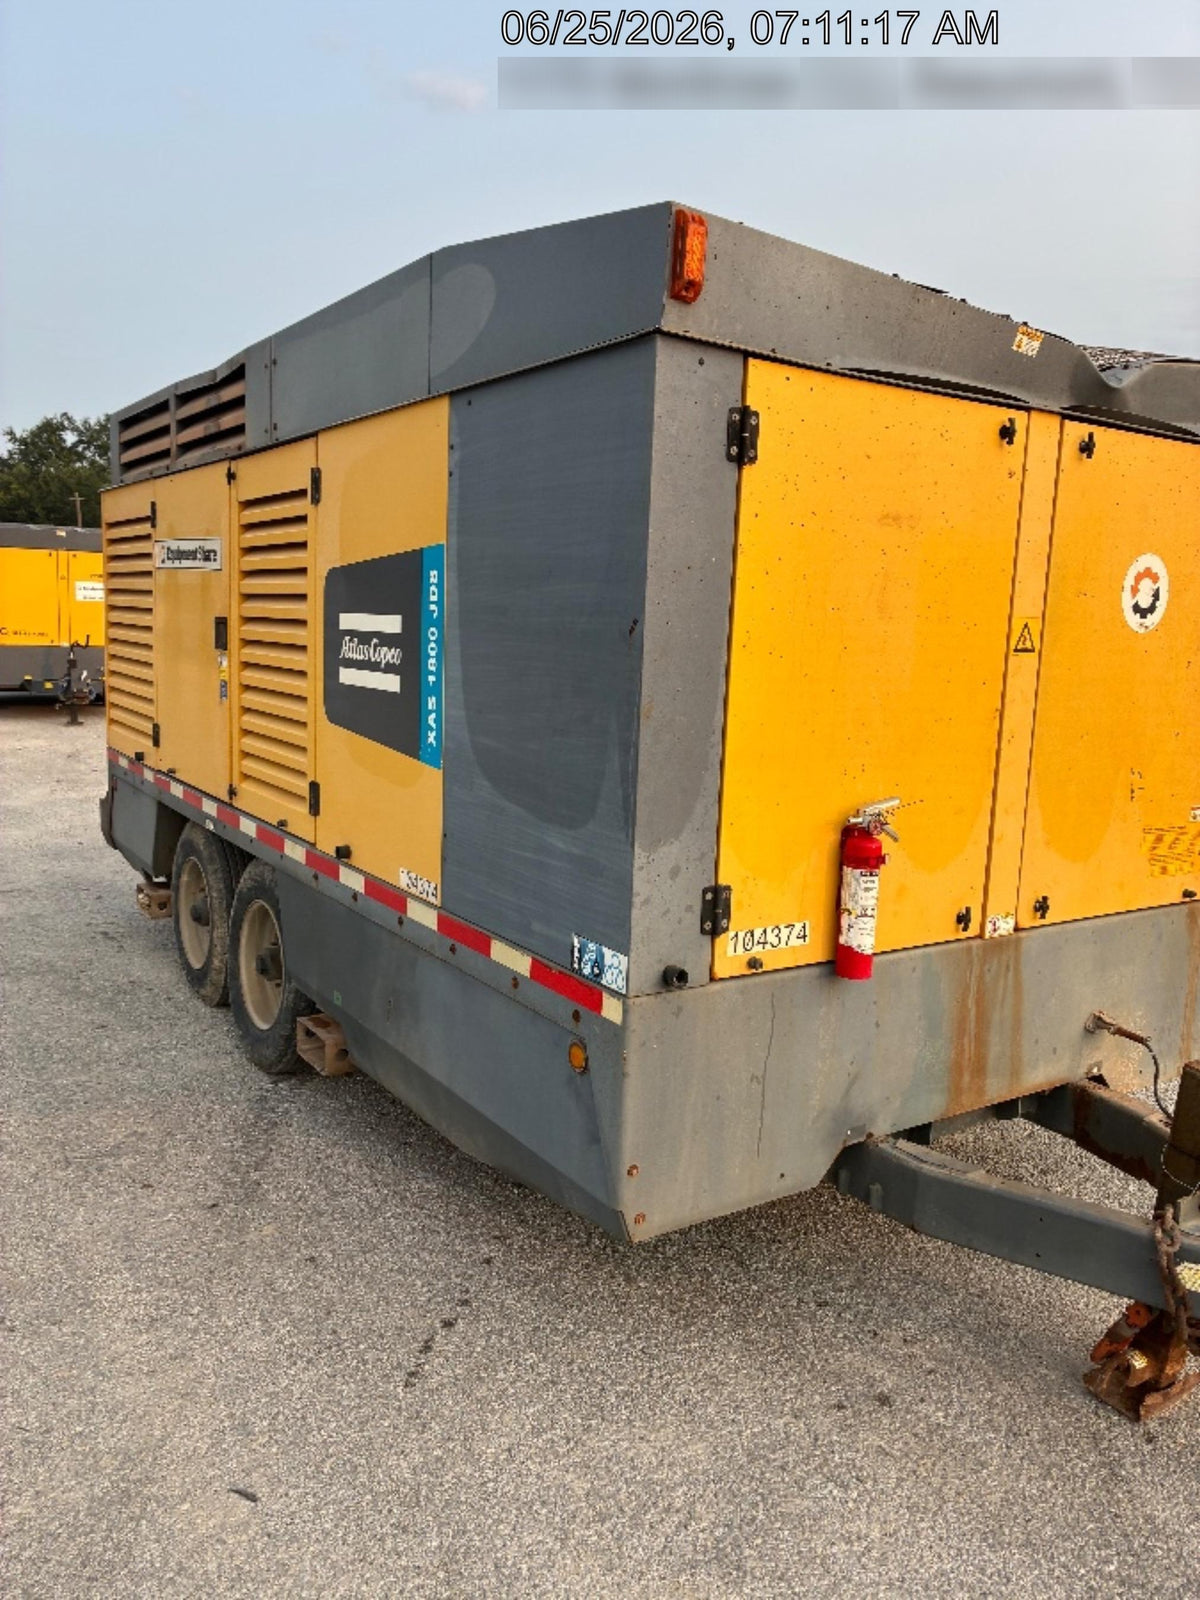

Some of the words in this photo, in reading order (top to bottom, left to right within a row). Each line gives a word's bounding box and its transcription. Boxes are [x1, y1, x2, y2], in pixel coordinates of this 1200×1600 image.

[339, 635, 369, 661] Atlas
[369, 637, 402, 669] Copco
[428, 626, 439, 687] 1800
[428, 695, 437, 748] XAS
[730, 922, 808, 954] 104374
